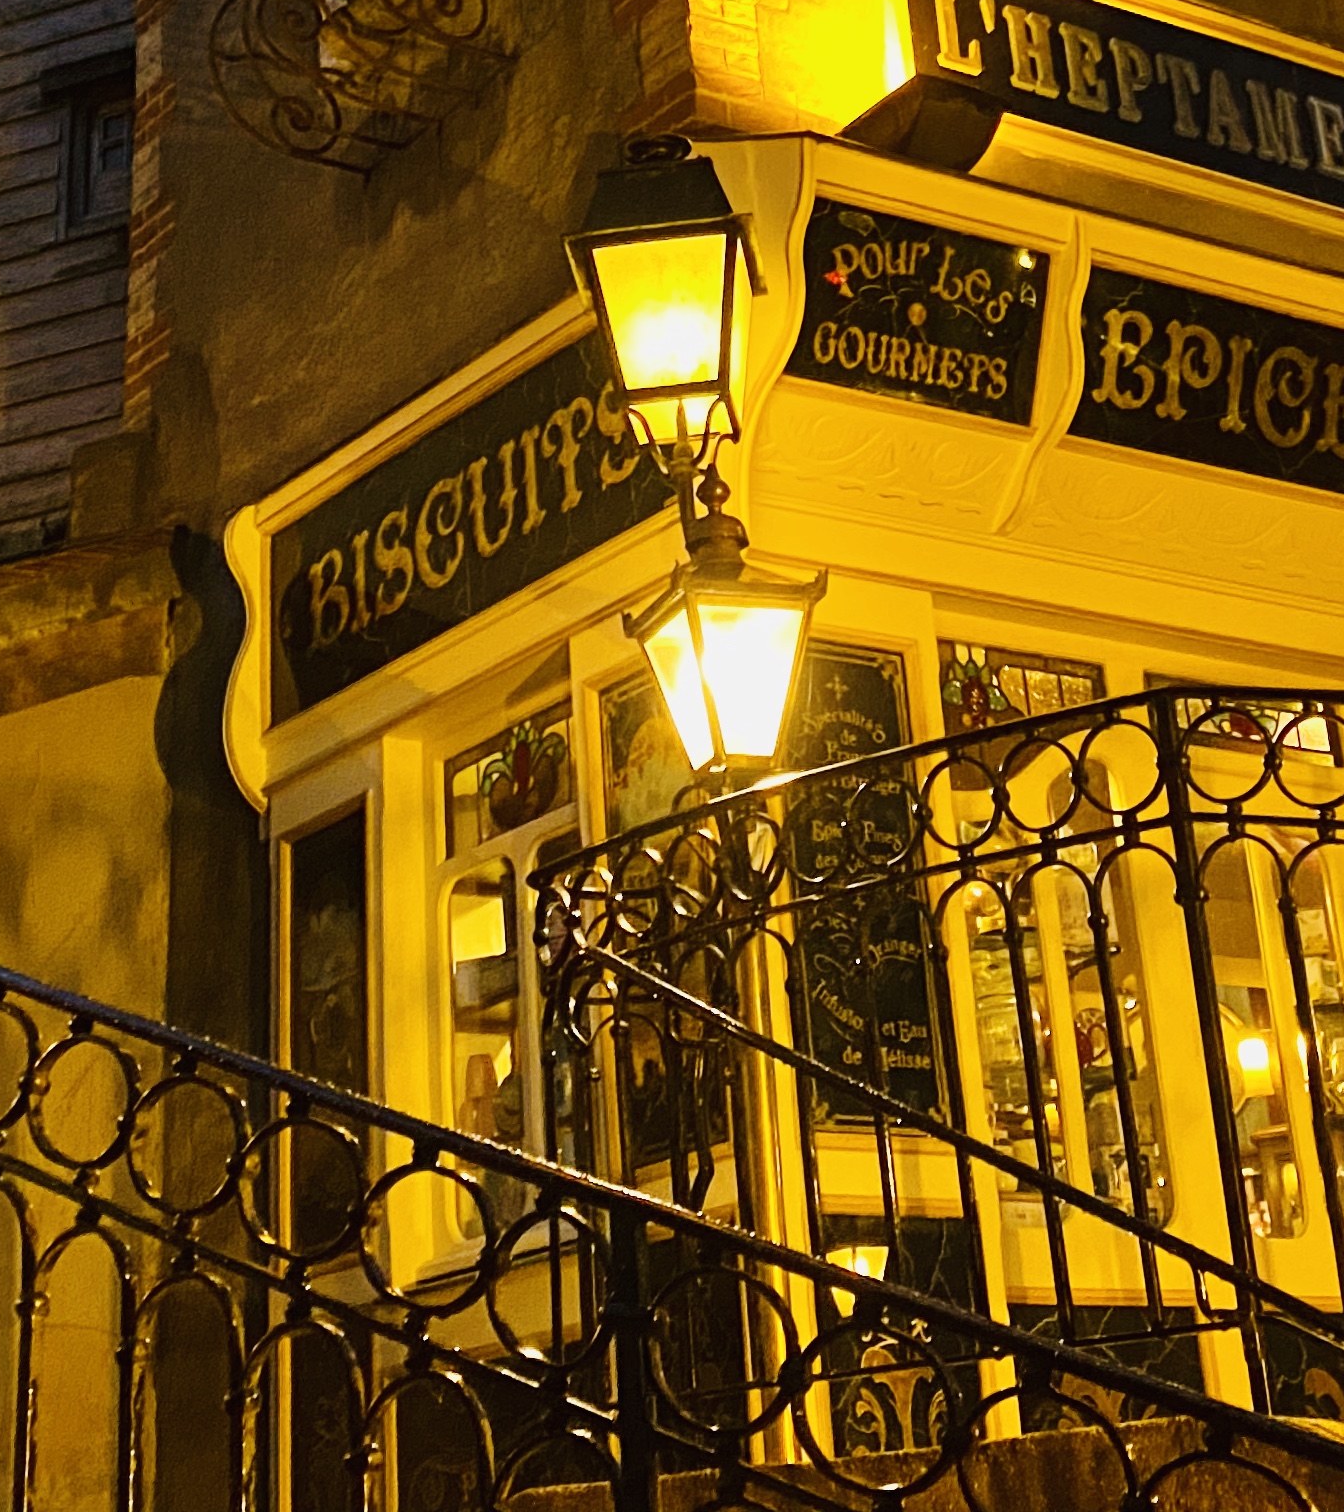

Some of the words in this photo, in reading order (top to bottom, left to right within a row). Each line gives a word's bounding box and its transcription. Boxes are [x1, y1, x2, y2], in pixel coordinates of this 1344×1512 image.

[813, 321, 1008, 400] GOURMETS
[308, 378, 641, 648] BISCUITS
[842, 1045, 862, 1065] de
